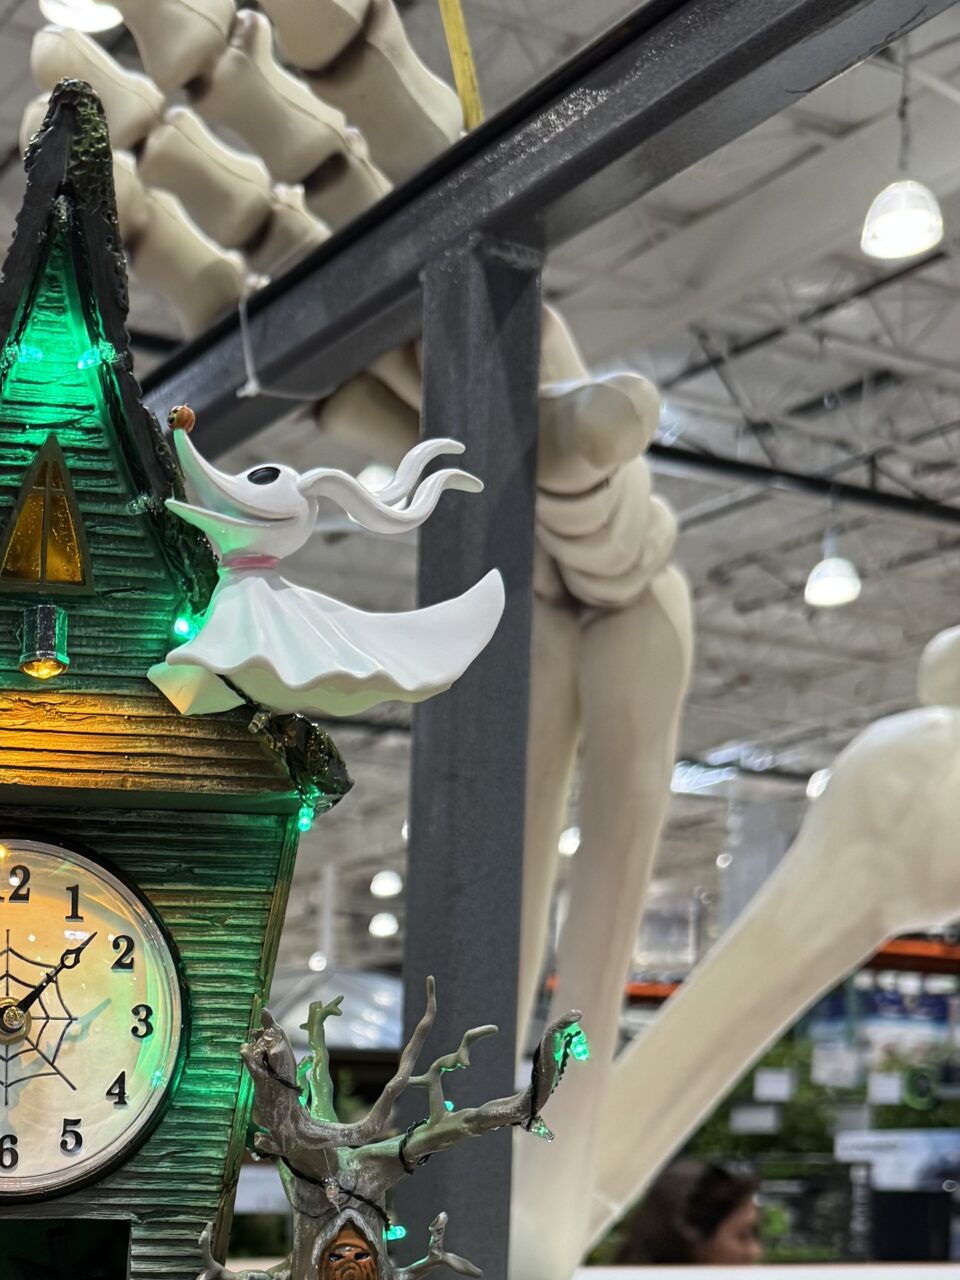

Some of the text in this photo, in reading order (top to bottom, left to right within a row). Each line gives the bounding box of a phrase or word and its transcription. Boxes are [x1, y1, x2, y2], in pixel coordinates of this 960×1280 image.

[65, 884, 84, 922] 1
[111, 934, 135, 972] 2
[130, 1003, 154, 1039] 3
[105, 1070, 129, 1106] 4
[59, 1117, 83, 1153] 5
